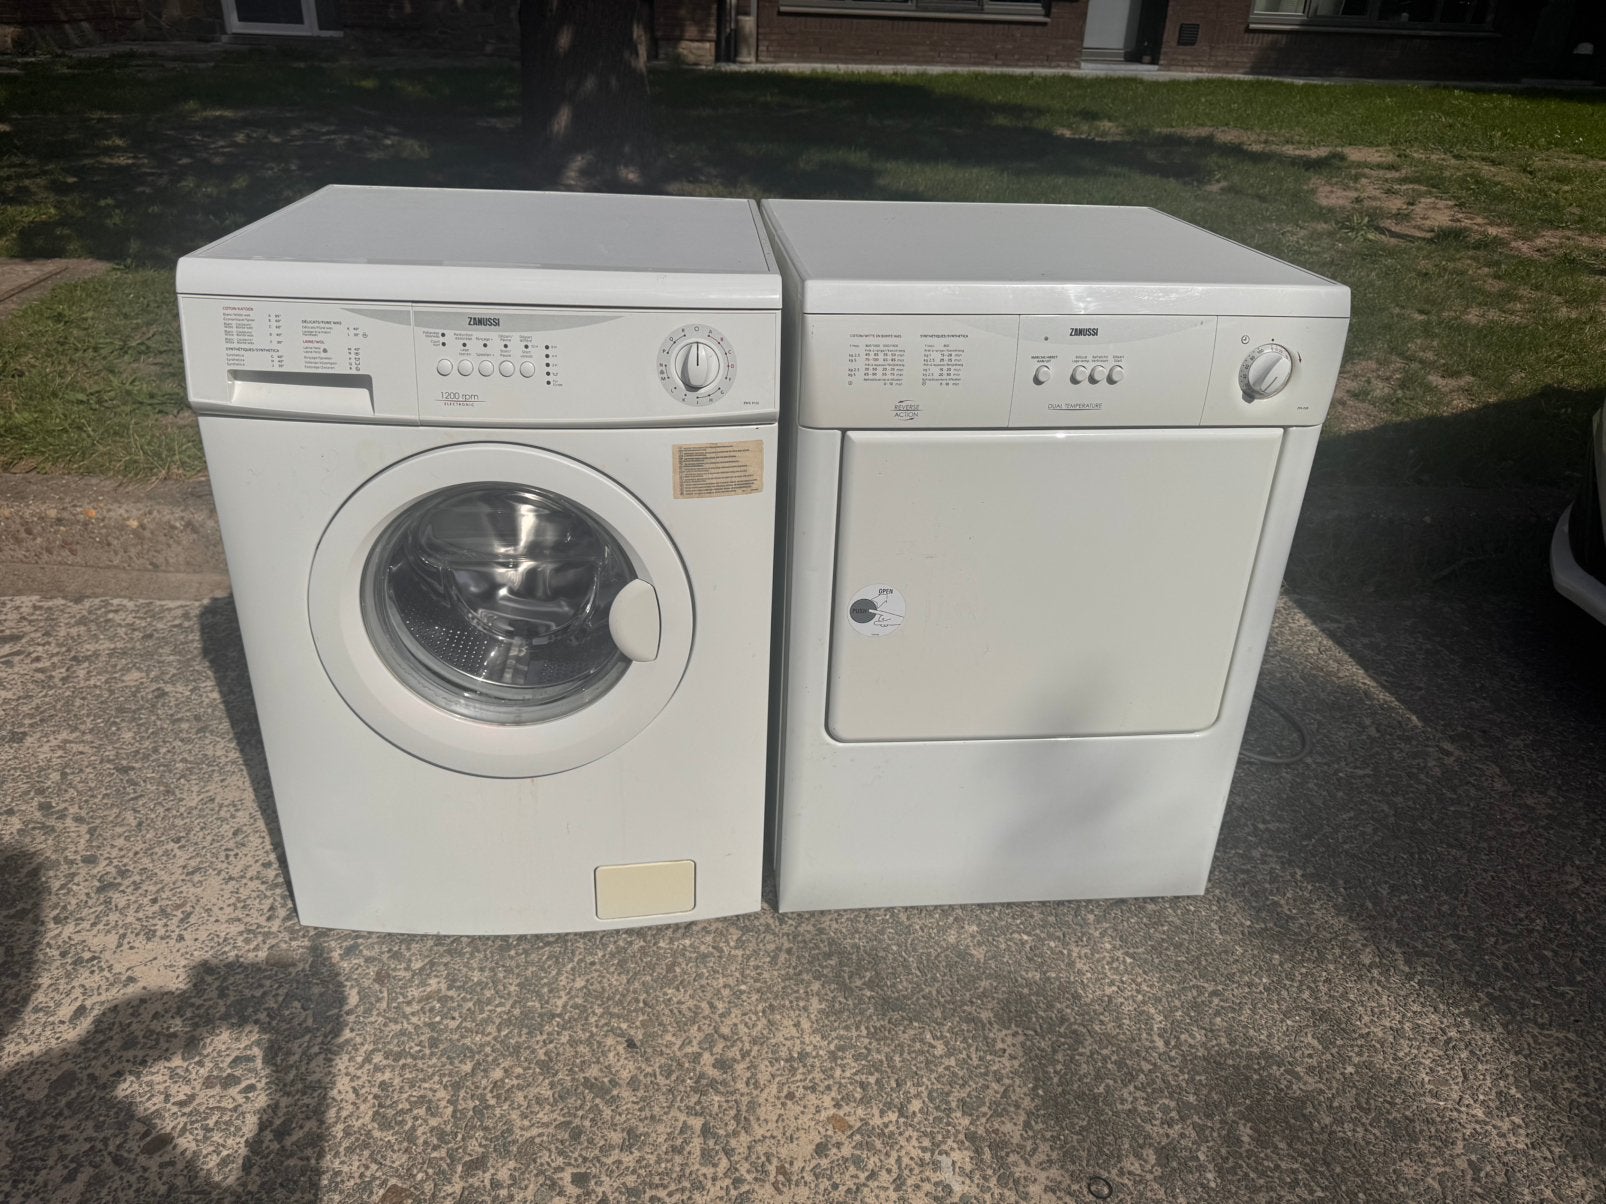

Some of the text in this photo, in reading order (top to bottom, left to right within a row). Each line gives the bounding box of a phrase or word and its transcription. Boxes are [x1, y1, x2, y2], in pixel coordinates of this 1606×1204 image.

[468, 316, 500, 326] ZANUSSI
[1070, 328, 1098, 336] ZANUSSI
[440, 392, 479, 401] 1200 rpm
